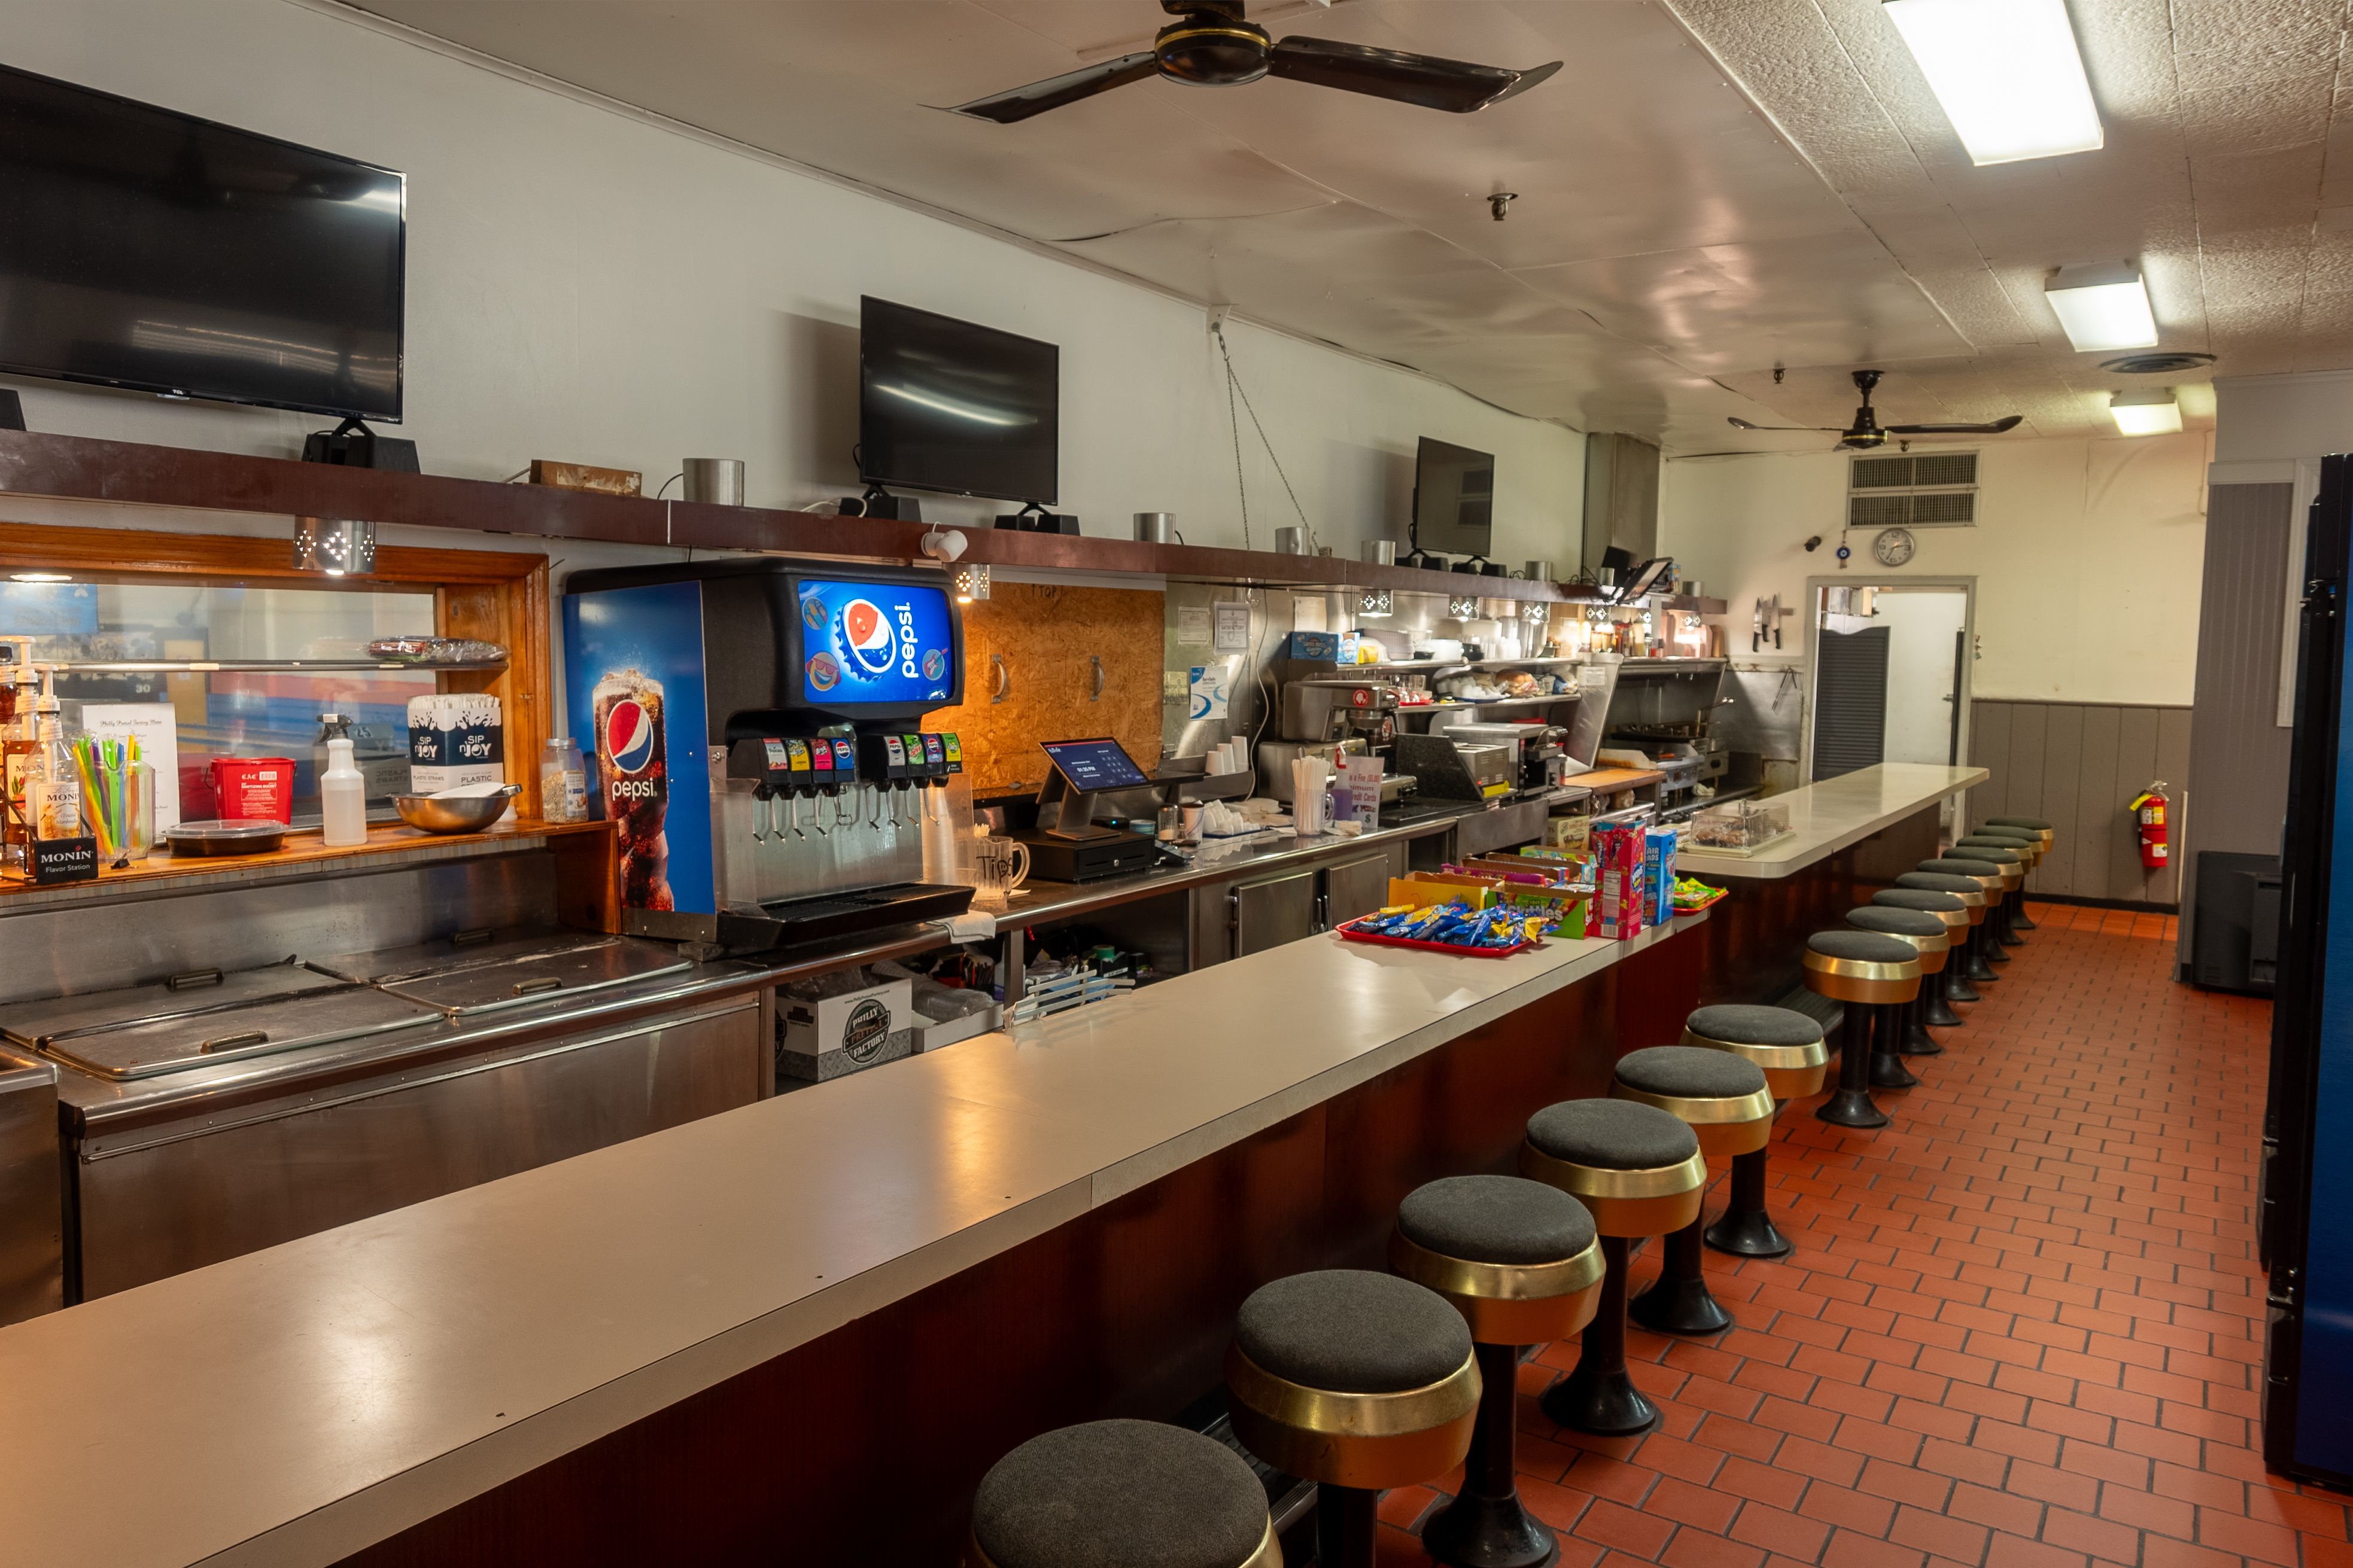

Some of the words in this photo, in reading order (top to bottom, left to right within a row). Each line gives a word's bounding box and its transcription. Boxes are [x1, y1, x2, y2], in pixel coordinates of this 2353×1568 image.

[1039, 585, 1057, 598] TOP
[894, 604, 919, 678] pepsi
[419, 736, 431, 745] SIP
[467, 735, 484, 744] SIP
[612, 777, 653, 801] pepsi
[1364, 793, 1376, 802] Cards
[41, 850, 92, 863] MONIN
[976, 855, 1012, 884] Tips
[853, 1006, 878, 1029] PHILLY
[852, 1020, 883, 1044] PRETZEL
[853, 1031, 885, 1058] FACTORY
